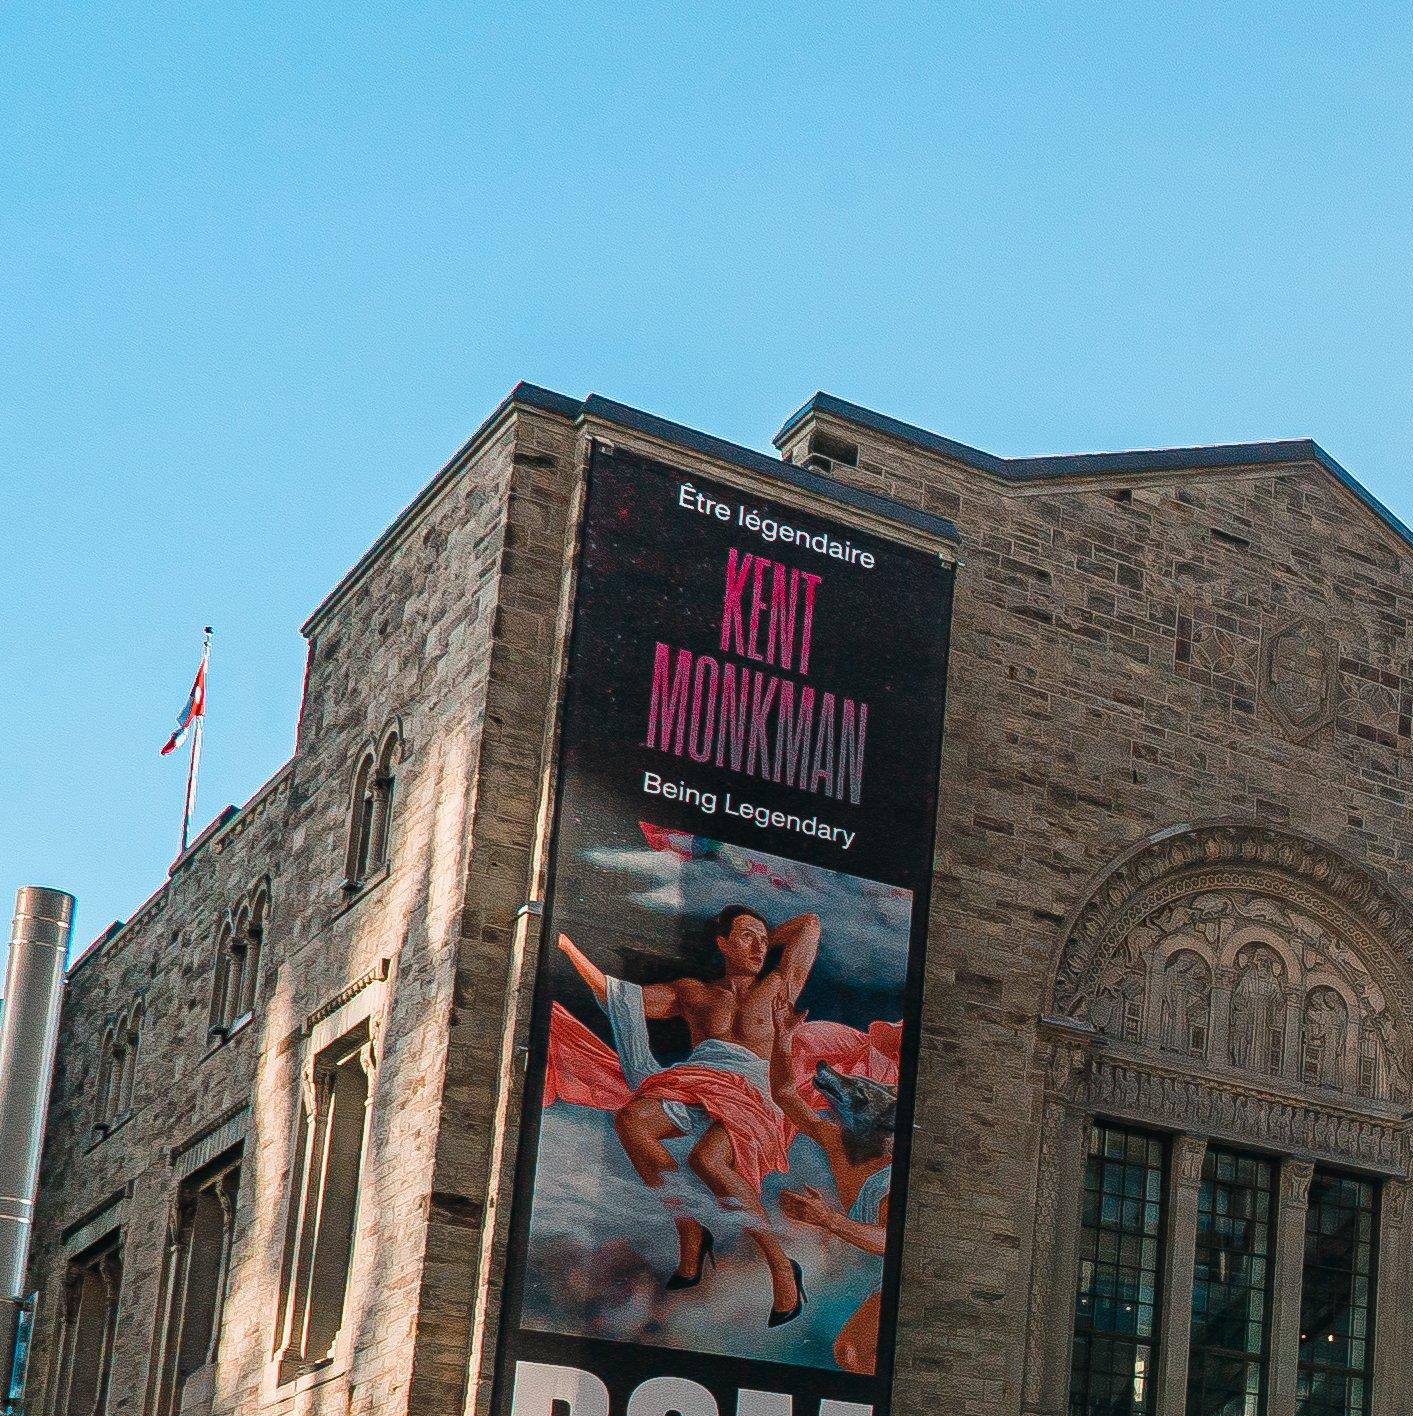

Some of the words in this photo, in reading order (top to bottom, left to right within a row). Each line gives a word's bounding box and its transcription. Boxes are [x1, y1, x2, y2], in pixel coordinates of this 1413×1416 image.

[679, 482, 731, 521] Être
[739, 505, 875, 569] légendaire
[720, 547, 823, 676] KENT
[646, 641, 869, 806] MONKMAN
[643, 771, 717, 814] Being
[725, 793, 856, 850] Legendary
